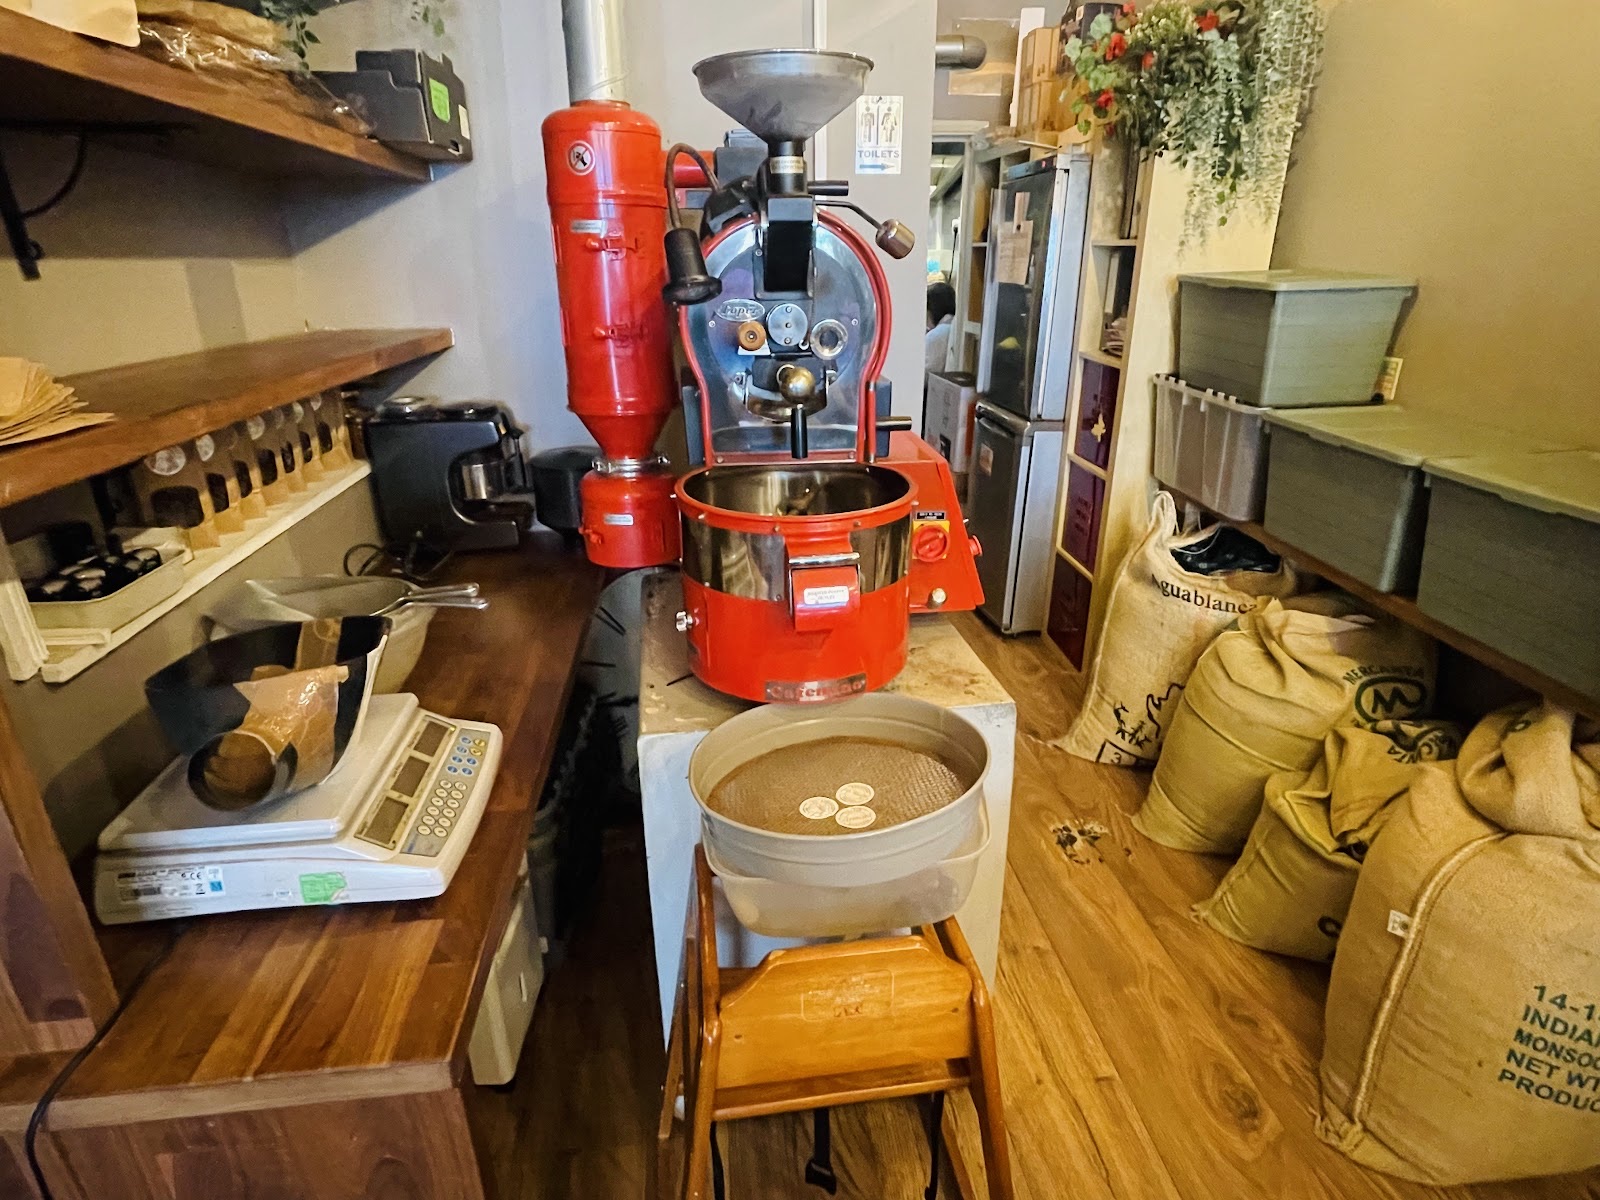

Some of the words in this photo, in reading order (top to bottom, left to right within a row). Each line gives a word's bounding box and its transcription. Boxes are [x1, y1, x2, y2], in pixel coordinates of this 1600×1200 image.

[858, 150, 900, 159] TOILETS
[1533, 985, 1600, 1021] 14-1
[1507, 1048, 1561, 1078] NET
